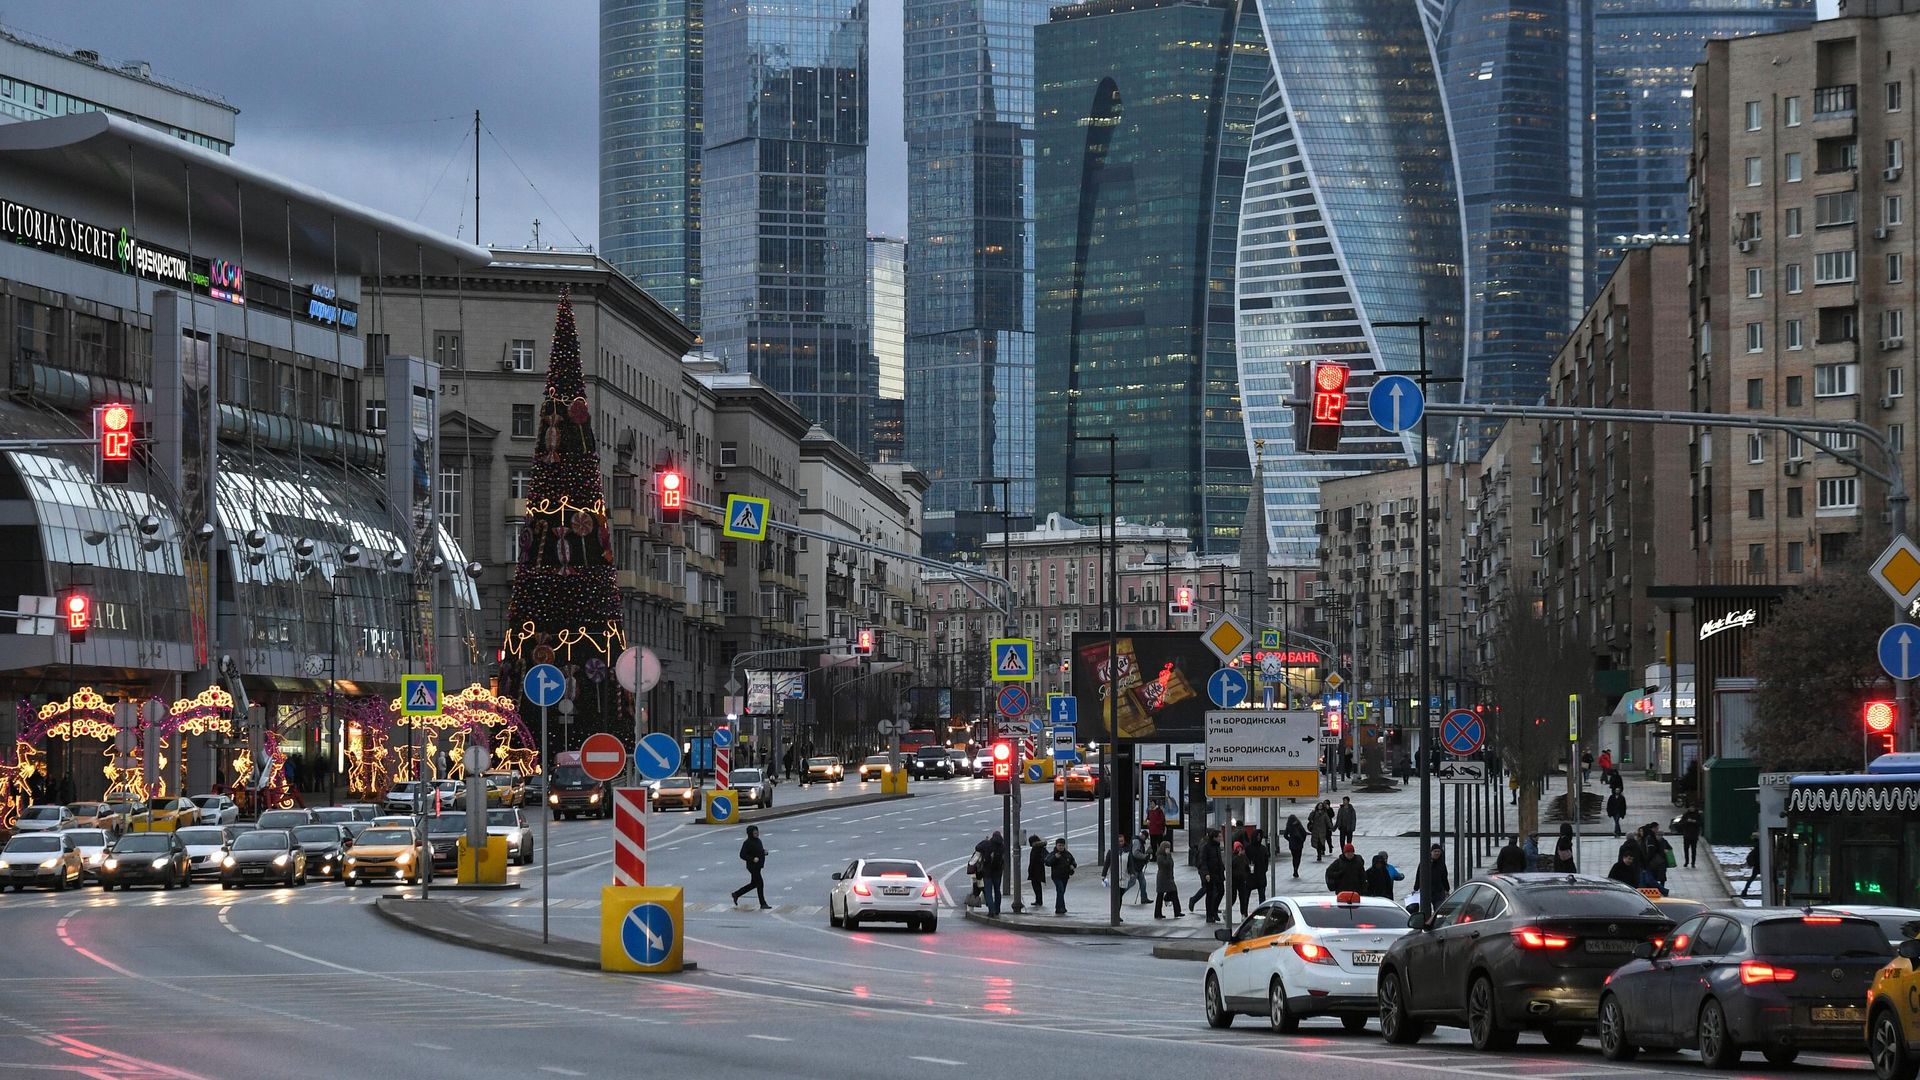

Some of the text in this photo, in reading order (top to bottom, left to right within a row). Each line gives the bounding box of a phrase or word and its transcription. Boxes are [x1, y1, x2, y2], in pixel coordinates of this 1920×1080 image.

[70, 218, 116, 261] SECRET
[1316, 394, 1342, 421] 02
[106, 433, 128, 457] 02
[664, 490, 680, 507] 03
[70, 613, 85, 629] 02
[1223, 717, 1286, 725] БОРОДИНСКАЯ
[1223, 746, 1286, 754] БОРОДИНСКАЯ
[1288, 750, 1300, 758] 0.3
[996, 763, 1009, 776] 02
